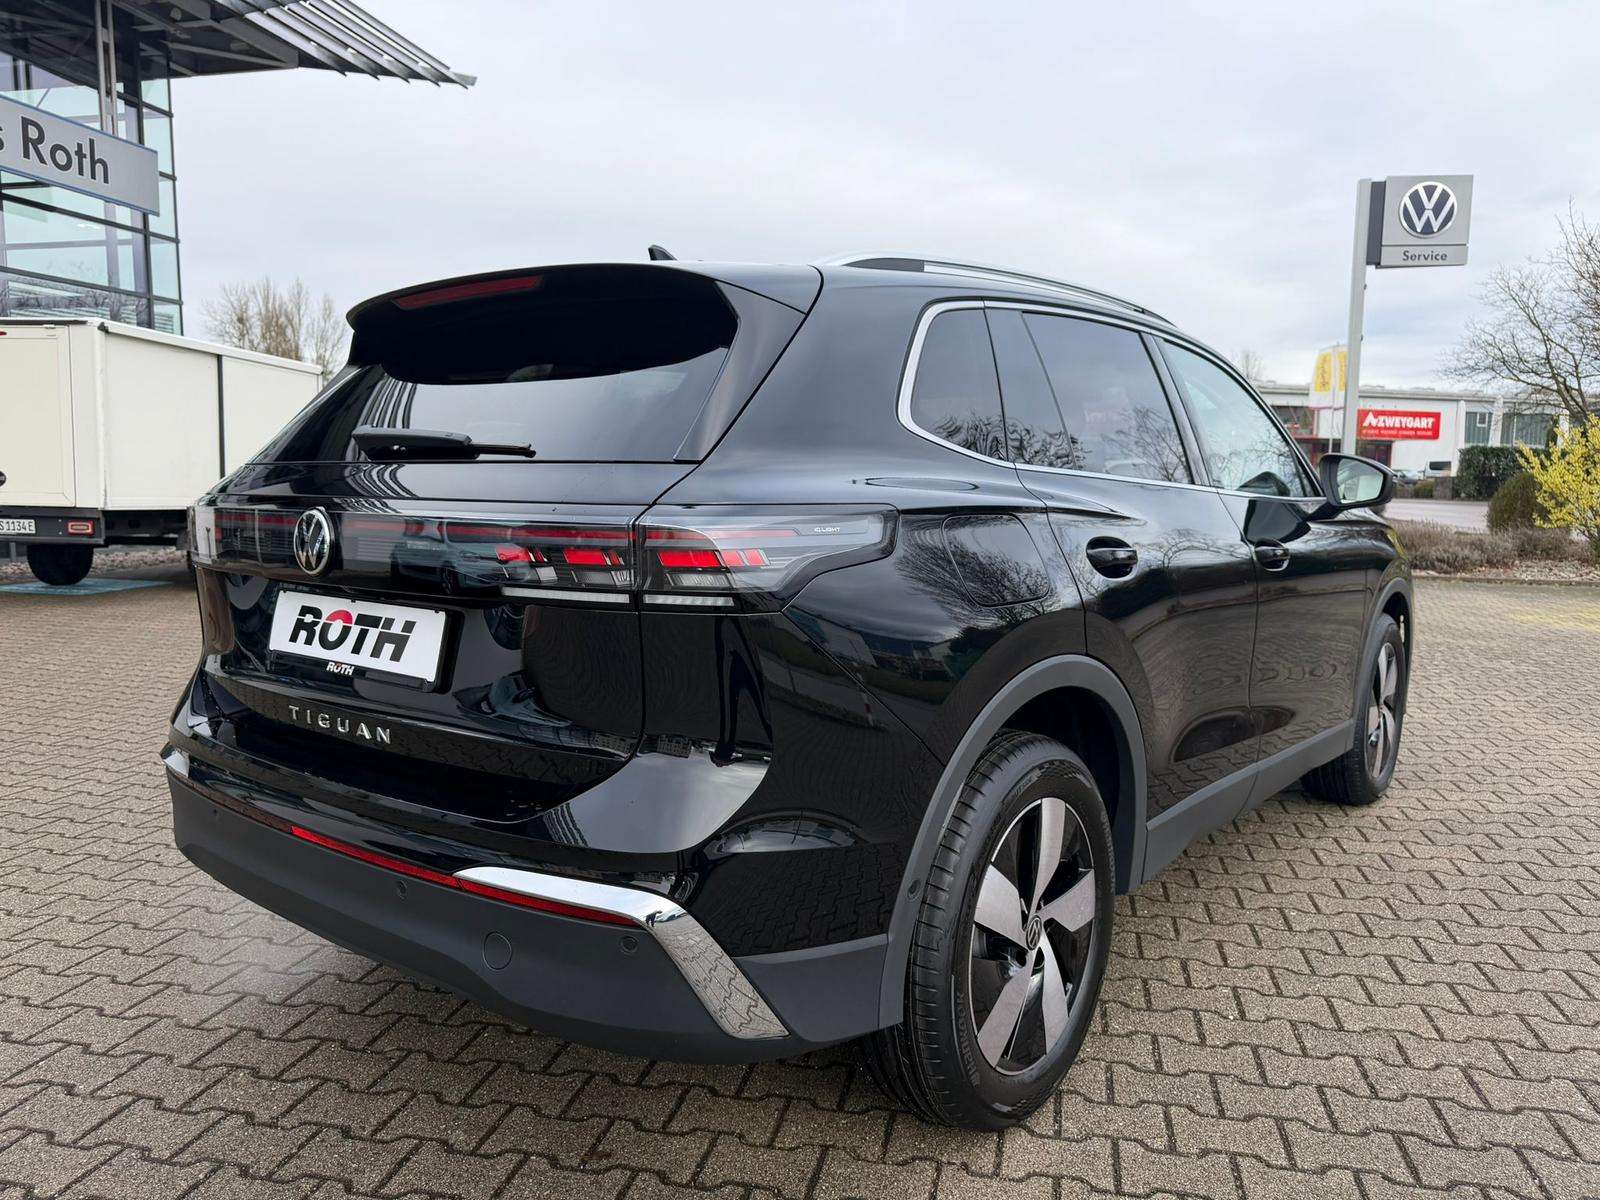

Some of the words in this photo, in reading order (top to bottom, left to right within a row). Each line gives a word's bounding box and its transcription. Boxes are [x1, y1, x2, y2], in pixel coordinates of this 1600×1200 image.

[21, 115, 110, 185] Roth
[1402, 250, 1448, 261] Service
[288, 605, 417, 662] ROTH
[326, 661, 355, 676] ROTH
[288, 704, 392, 744] TIGUAN
